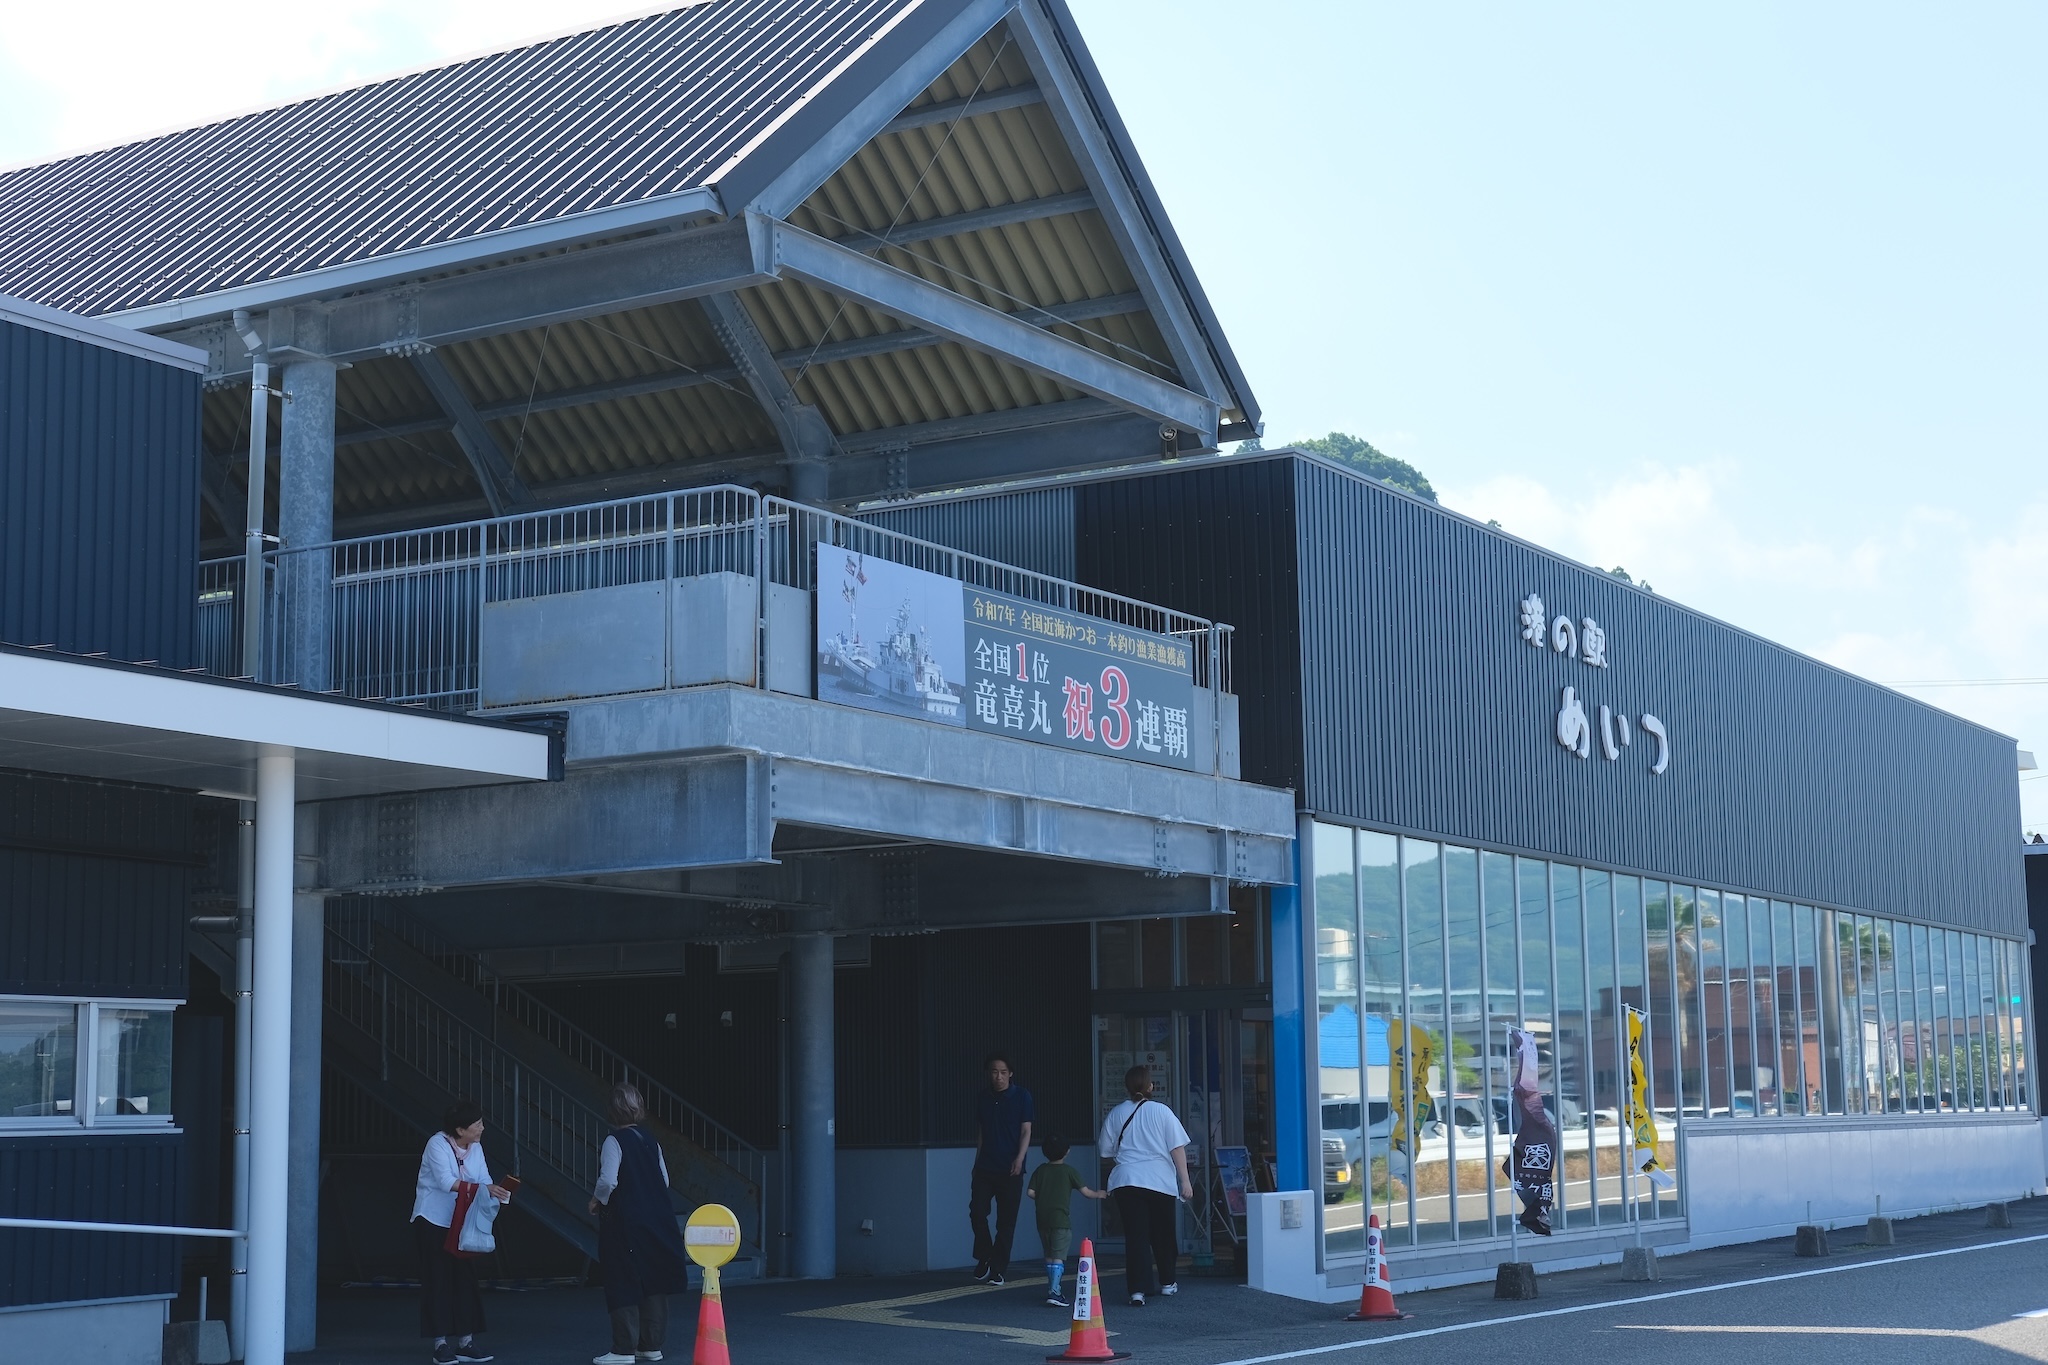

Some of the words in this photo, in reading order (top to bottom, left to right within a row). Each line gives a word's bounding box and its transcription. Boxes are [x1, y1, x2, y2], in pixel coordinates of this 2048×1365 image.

[972, 597, 1016, 627] 令和7年
[973, 637, 1050, 685] 全国1位
[973, 678, 1052, 735] 竜喜丸
[1557, 686, 1669, 775] めいつ
[1368, 1247, 1377, 1284] 駐車禁止
[1077, 1275, 1088, 1318] 駐車禁止
